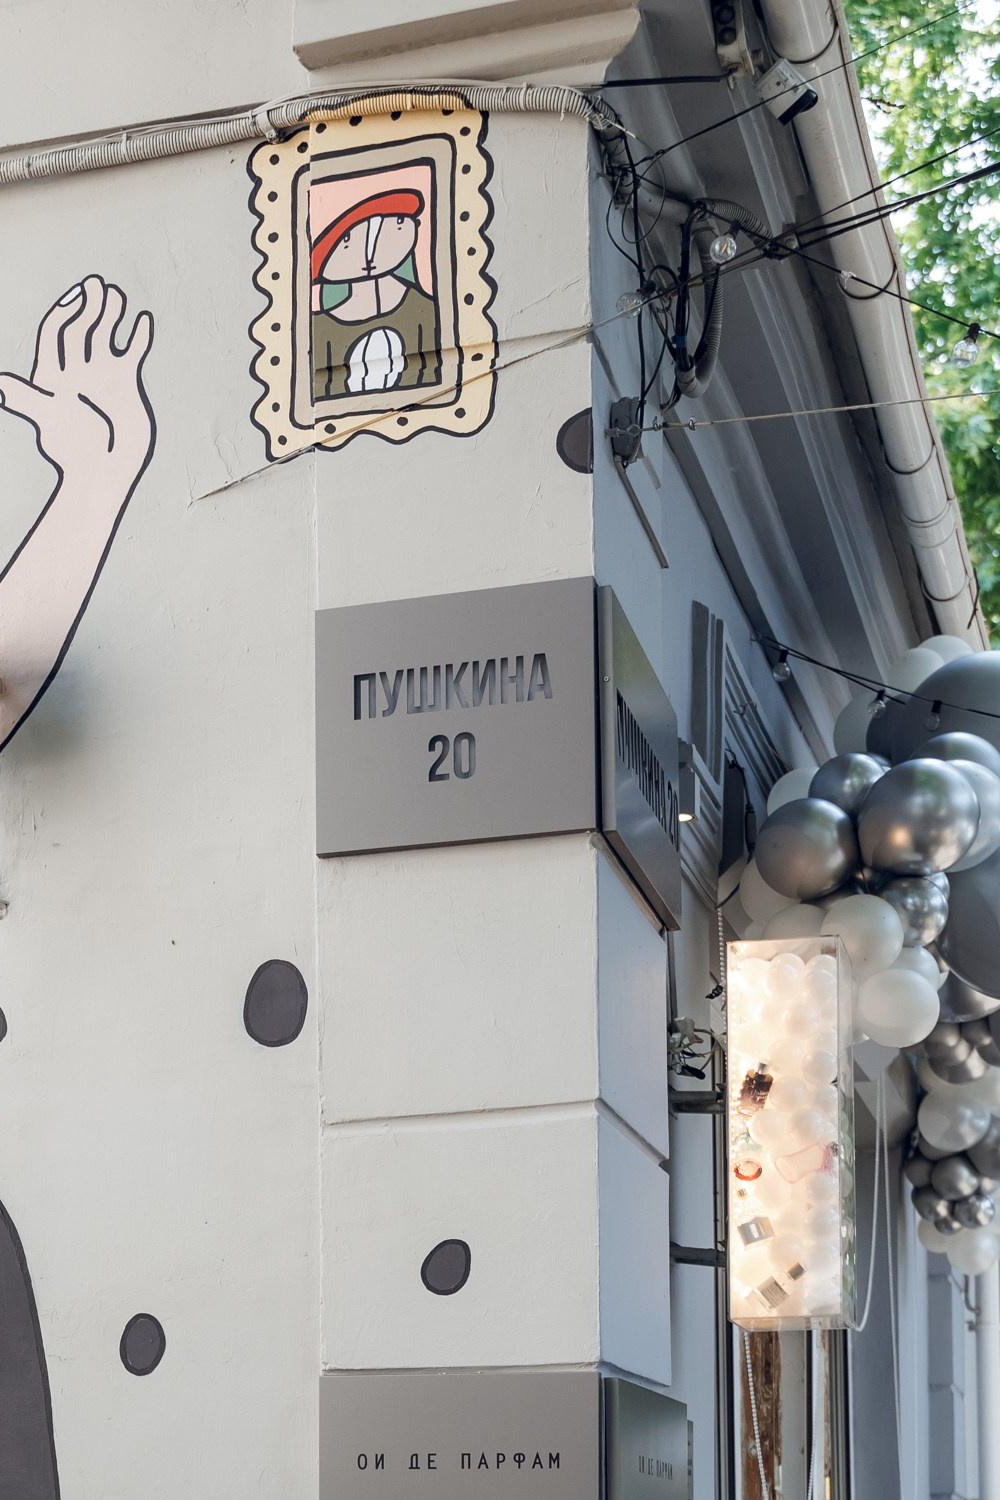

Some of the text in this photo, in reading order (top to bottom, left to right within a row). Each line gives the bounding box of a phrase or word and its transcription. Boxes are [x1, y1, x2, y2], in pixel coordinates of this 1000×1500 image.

[353, 652, 553, 721] ПУШКИНА
[428, 731, 476, 783] 20
[357, 1451, 561, 1470] ОИ ДЕ ПАРФАМ
